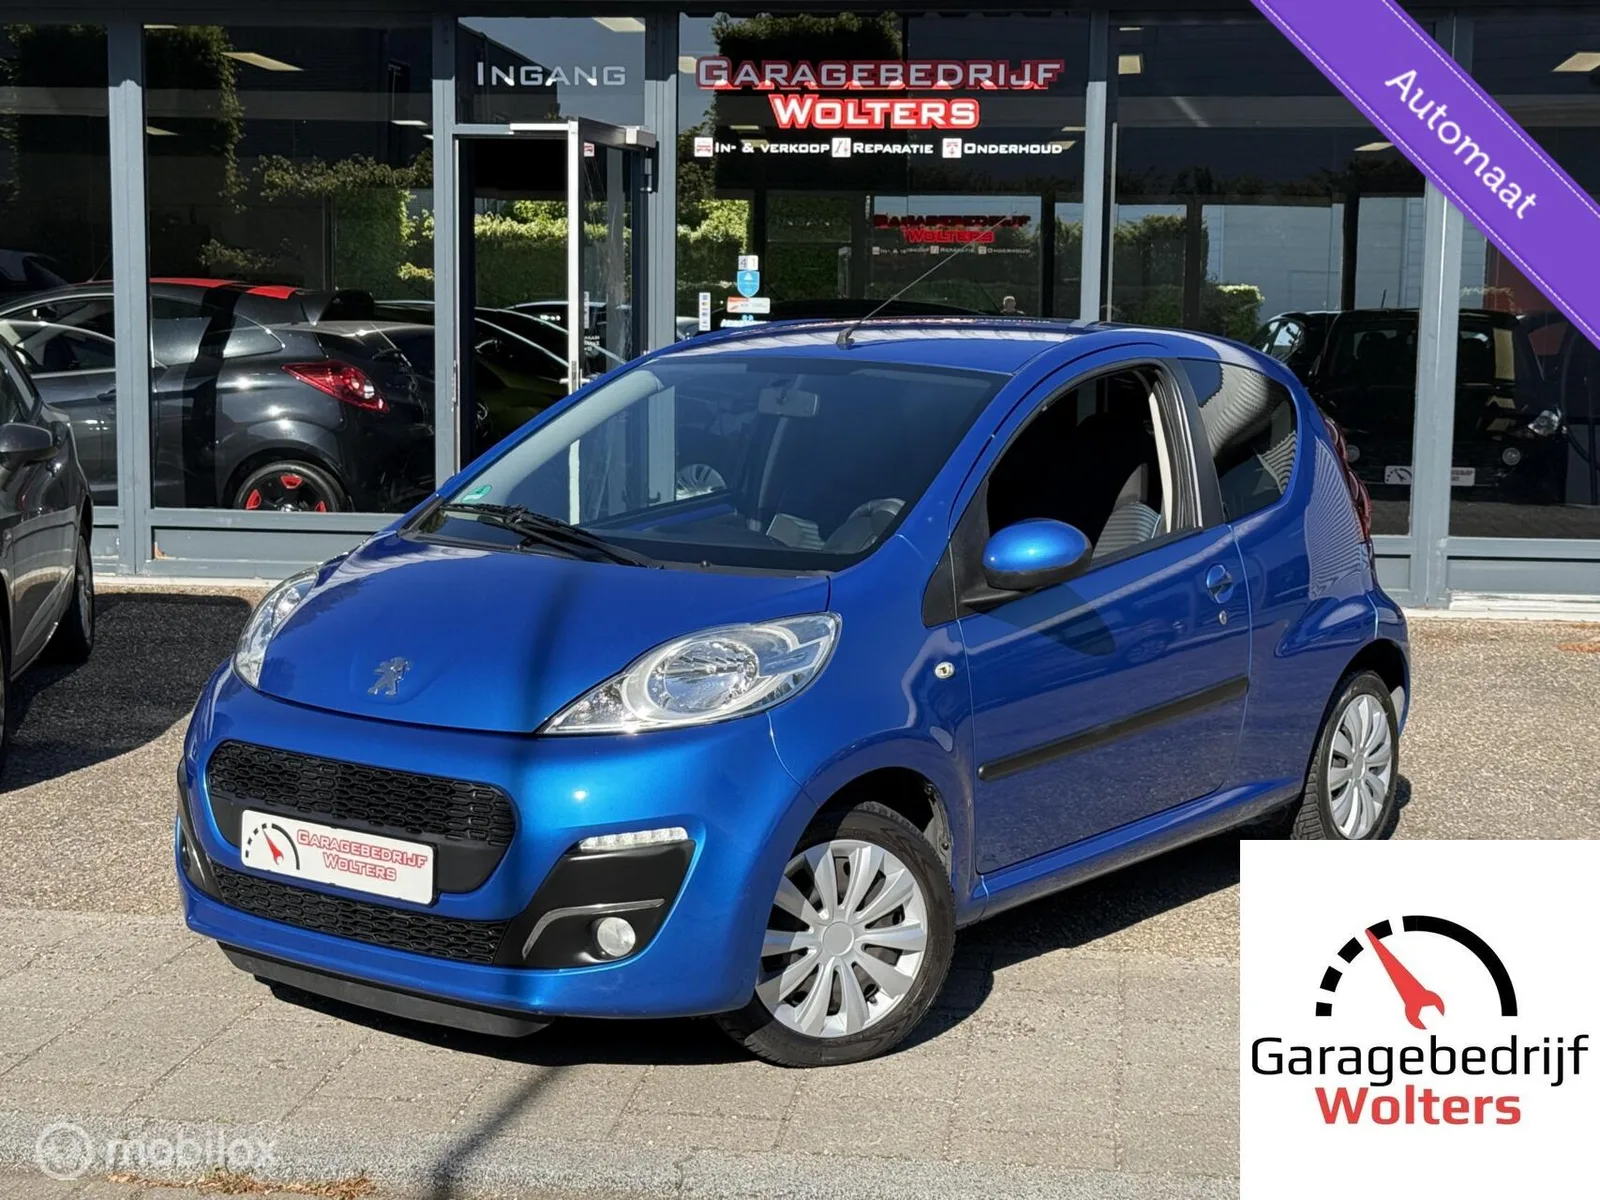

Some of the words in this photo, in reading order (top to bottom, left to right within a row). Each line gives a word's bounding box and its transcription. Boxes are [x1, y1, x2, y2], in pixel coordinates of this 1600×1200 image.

[477, 62, 625, 86] INGANG
[696, 58, 1064, 90] GARAGEBEDRIJF
[768, 94, 980, 129] WOLTERS
[714, 141, 737, 153] IN-
[742, 142, 755, 153] &
[760, 143, 830, 153] VERKOOP
[853, 142, 933, 154] REPARATIE
[964, 142, 1063, 154] ONDERHOUD
[297, 829, 428, 869] GARAGEBEDRIJF
[323, 852, 397, 881] WOLTERS
